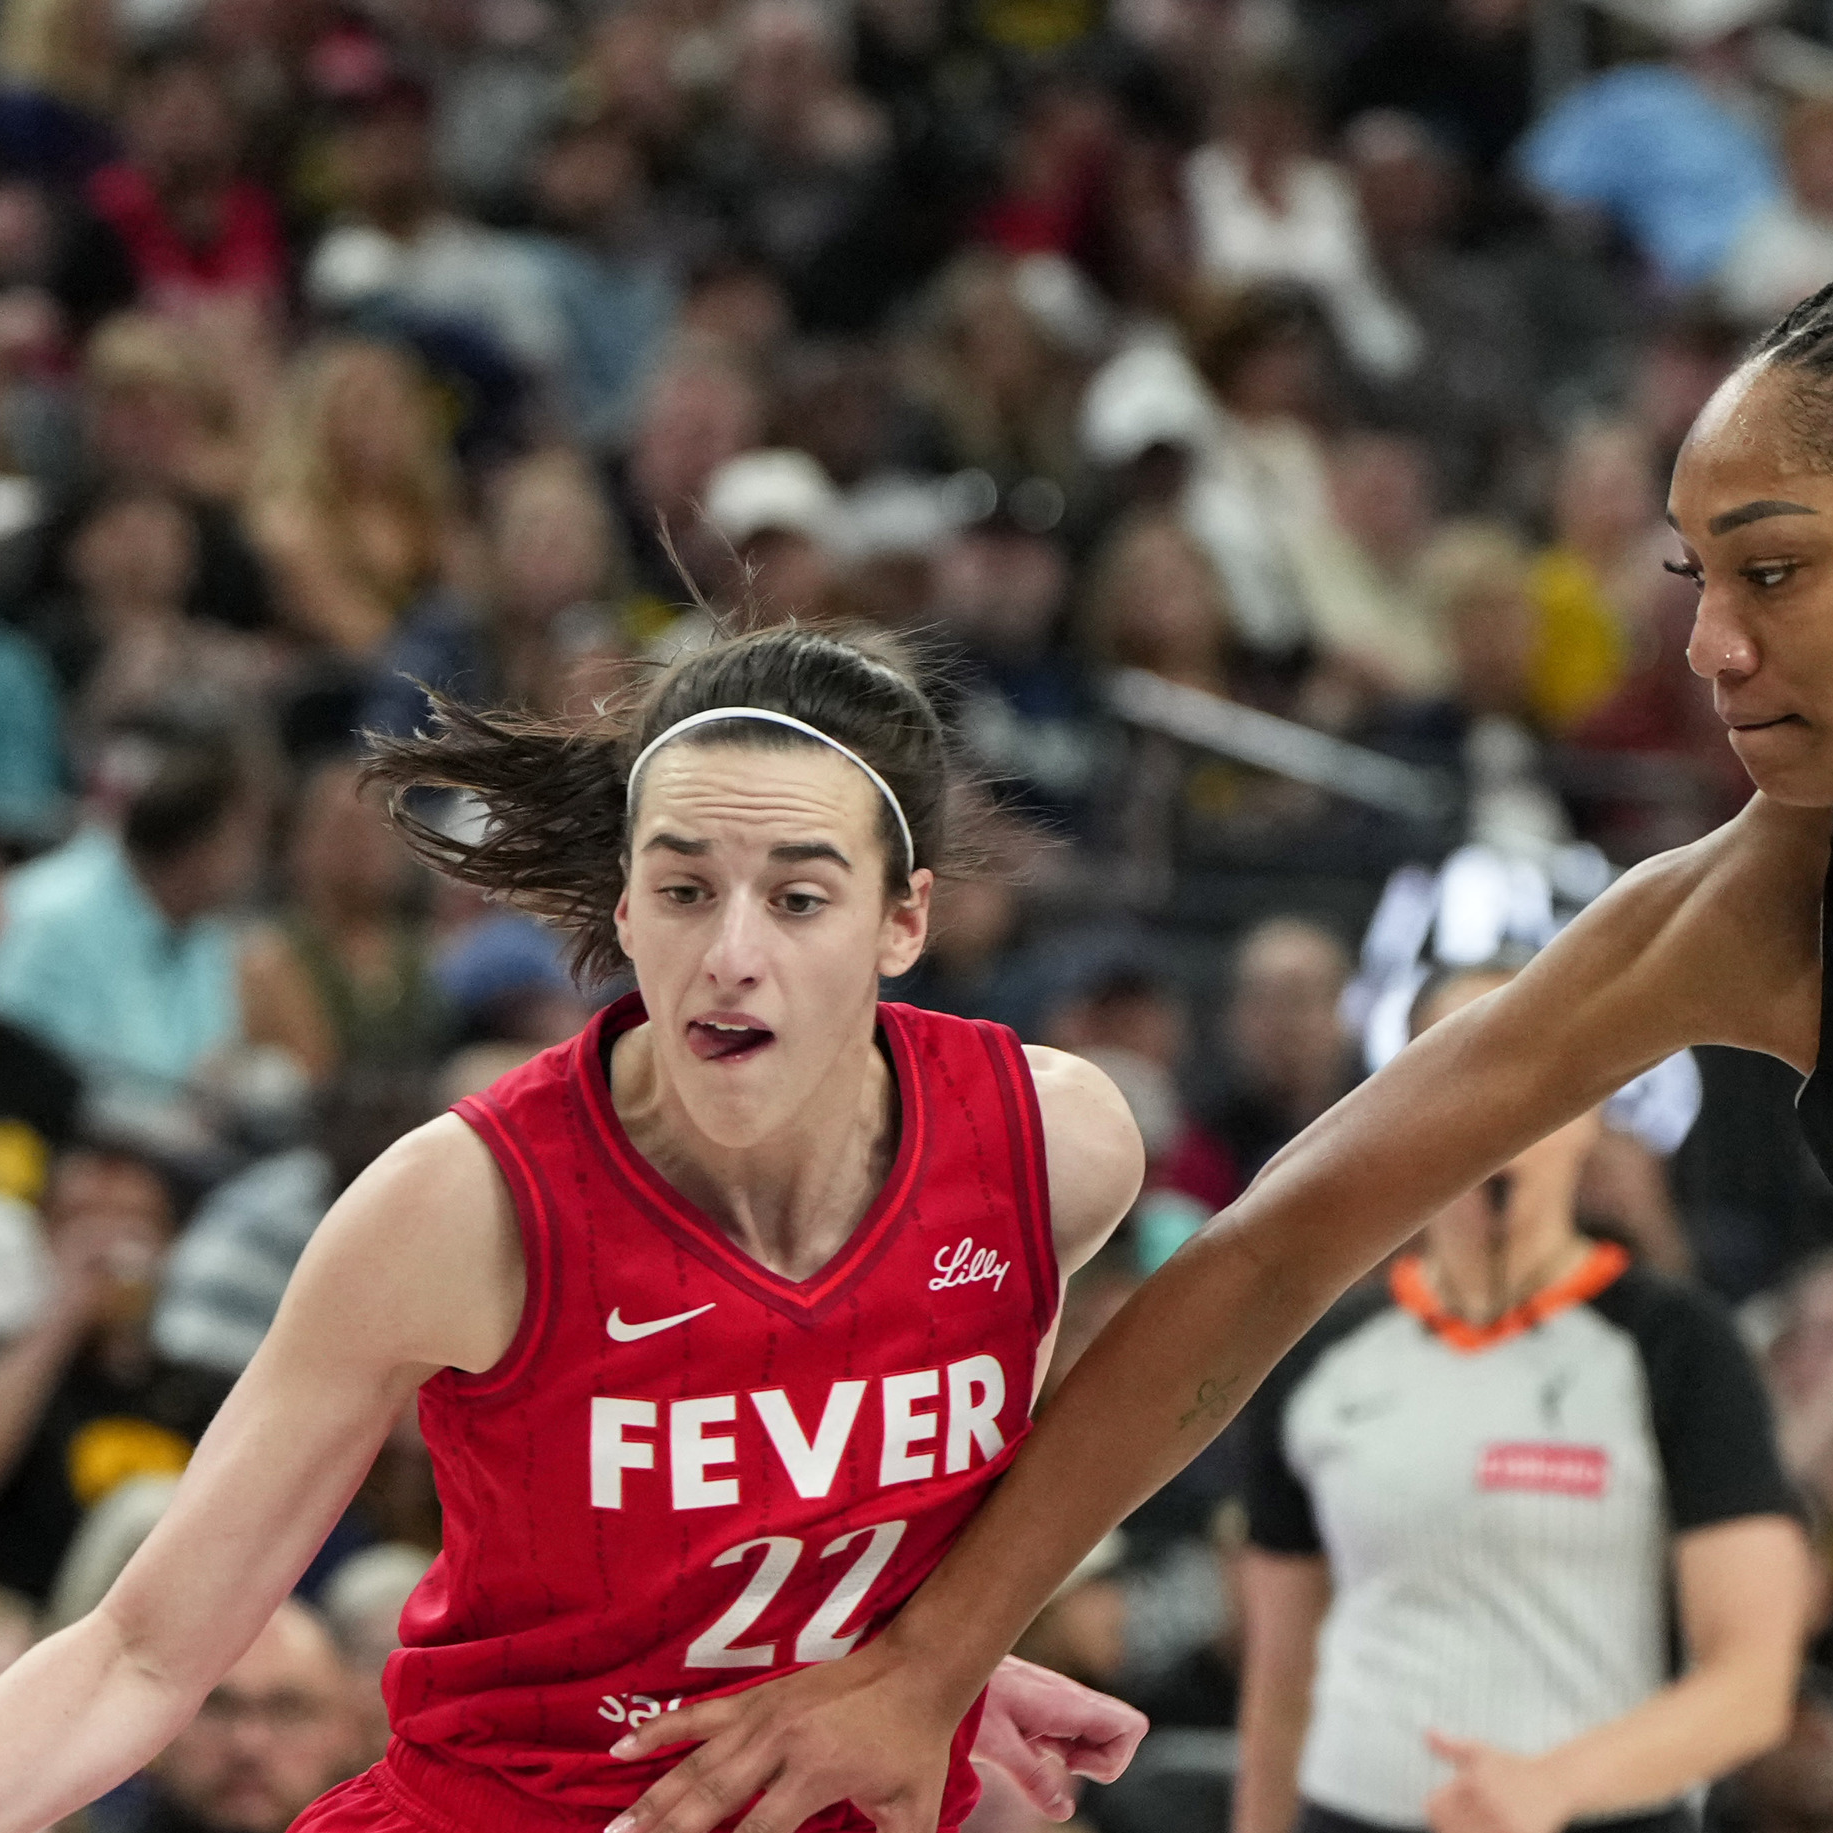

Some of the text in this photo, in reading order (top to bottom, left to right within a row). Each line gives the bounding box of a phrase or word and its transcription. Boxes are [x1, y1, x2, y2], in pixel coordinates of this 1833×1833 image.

[928, 1236, 1011, 1292] Lilly
[589, 1353, 1008, 1511] FEVER
[682, 1519, 908, 1670] 22
